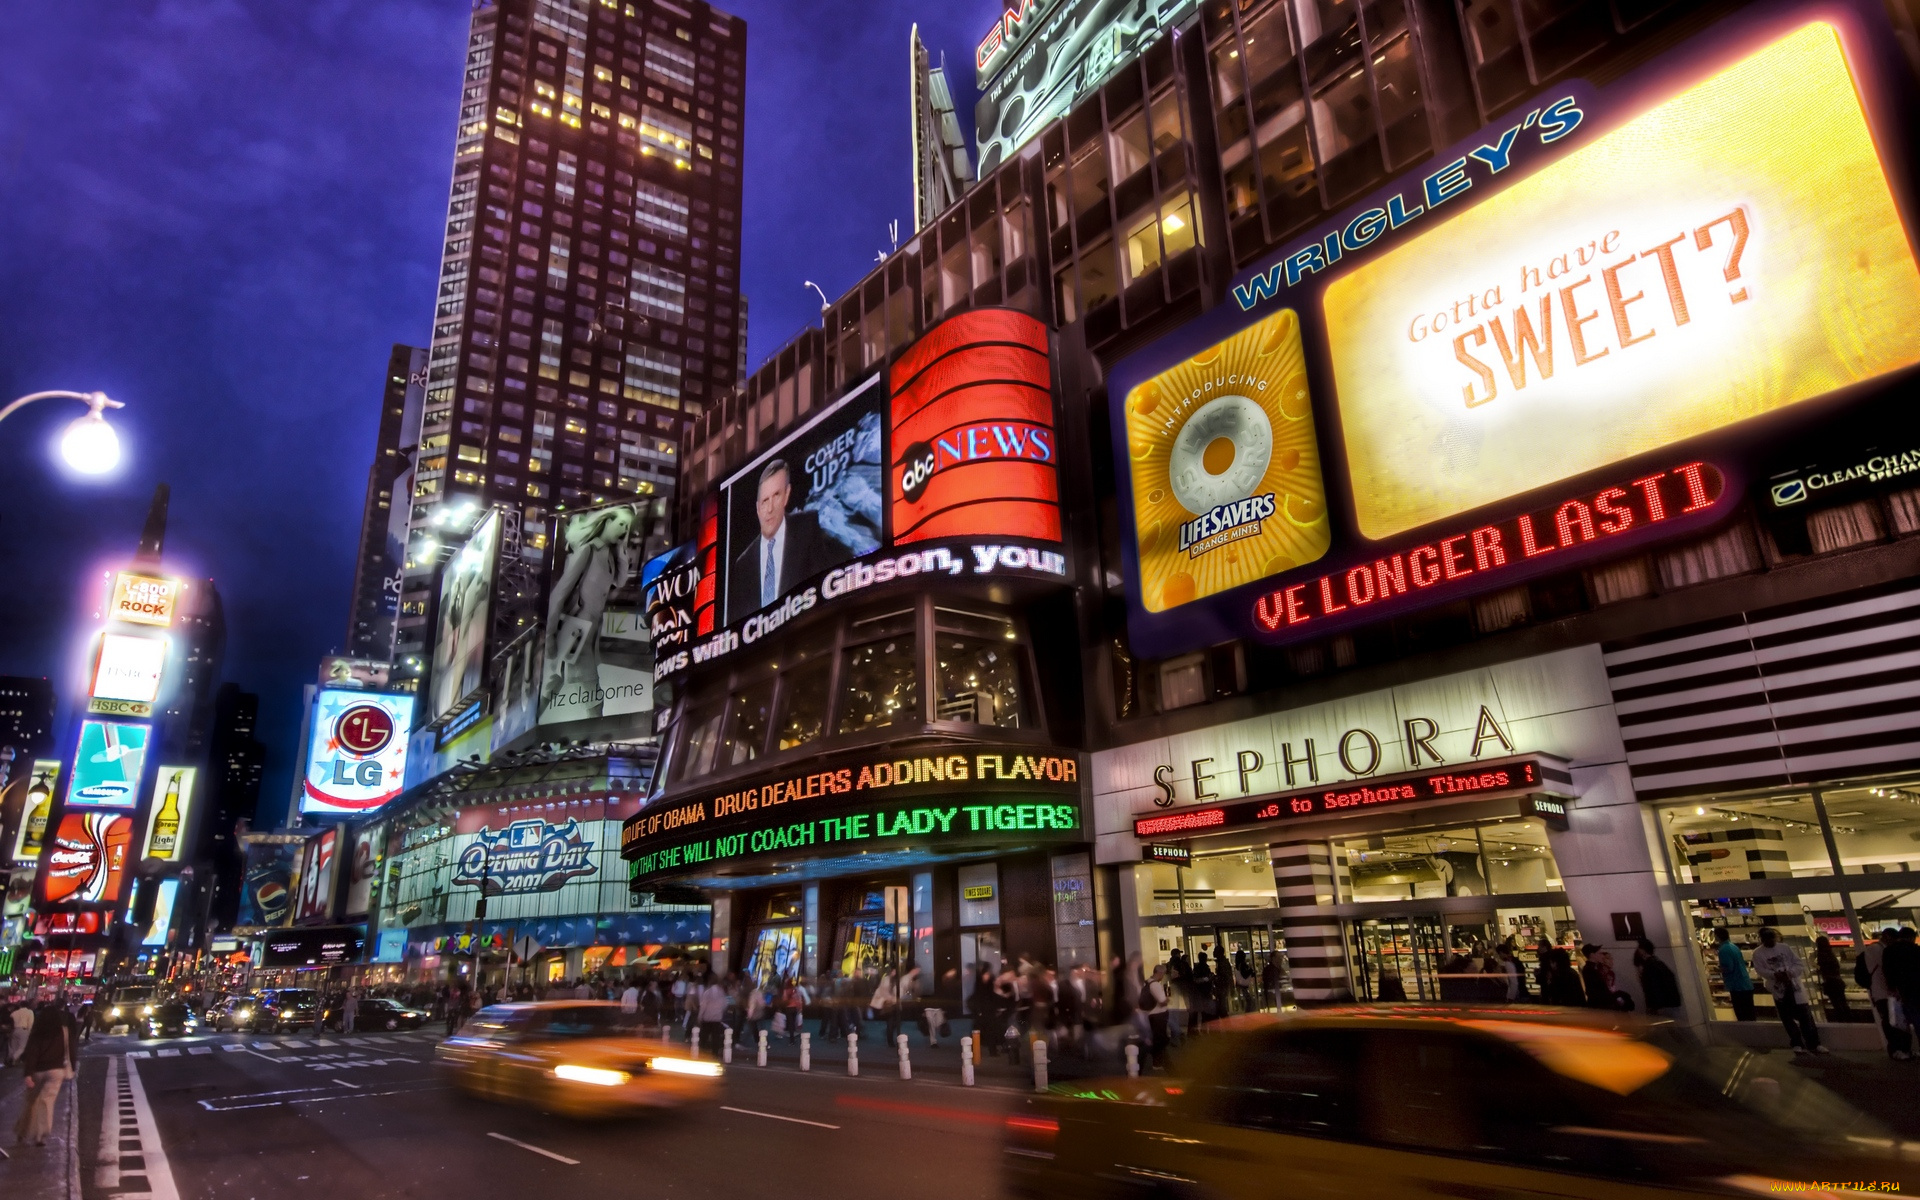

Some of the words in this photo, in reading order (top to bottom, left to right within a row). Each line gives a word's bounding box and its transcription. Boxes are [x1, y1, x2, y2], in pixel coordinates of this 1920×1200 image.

[990, 79, 1003, 103] THE
[1003, 64, 1019, 89] NEW
[1019, 43, 1037, 70] 2007
[1232, 96, 1585, 312] WRIGLEY'S
[1407, 285, 1505, 343] Gotta
[1520, 229, 1622, 293] have
[1453, 206, 1751, 409] SWEET?
[1160, 374, 1268, 436] INTRODUCING
[805, 428, 856, 474] COVER
[813, 451, 850, 492] UP?
[902, 452, 935, 492] abc
[937, 425, 1051, 470] NEWS
[1192, 532, 1229, 554] ORANGE
[1231, 523, 1259, 540] MINTS
[1257, 583, 1310, 629] VE
[1320, 526, 1506, 614] LONGER
[1520, 461, 1716, 557] LASTI
[120, 600, 164, 614] ROCK
[124, 581, 168, 595] 1-800
[692, 628, 740, 664] with
[742, 585, 818, 645] Charles
[821, 546, 963, 600] Gibson,
[605, 606, 628, 634] liz
[91, 700, 130, 713] HSBC
[549, 689, 566, 710] liz
[568, 683, 644, 706] claiborne
[332, 759, 383, 787] LG
[1153, 704, 1515, 808] SEPHORA
[631, 818, 647, 840] LIFE
[648, 813, 662, 834] OF
[663, 802, 706, 830] OBAMA
[714, 789, 758, 817] DRUG
[761, 768, 852, 807] DEALERS
[856, 755, 969, 791] ADDING
[976, 755, 1077, 783] FLAVOR
[1291, 797, 1313, 813] to
[1324, 783, 1416, 810] Sephora
[1429, 771, 1510, 796] Times
[1535, 800, 1565, 815] SEPHORA
[545, 839, 588, 868] DAY
[639, 851, 659, 874] THAT
[659, 847, 682, 869] SHE
[684, 840, 713, 864] WILL
[715, 832, 749, 859] NOT
[751, 822, 815, 852] COACH
[819, 814, 870, 842] THE
[877, 806, 957, 836] LADY
[962, 805, 1074, 831] TIGERS
[1153, 846, 1189, 858] SEPHORA
[503, 873, 542, 892] 2007
